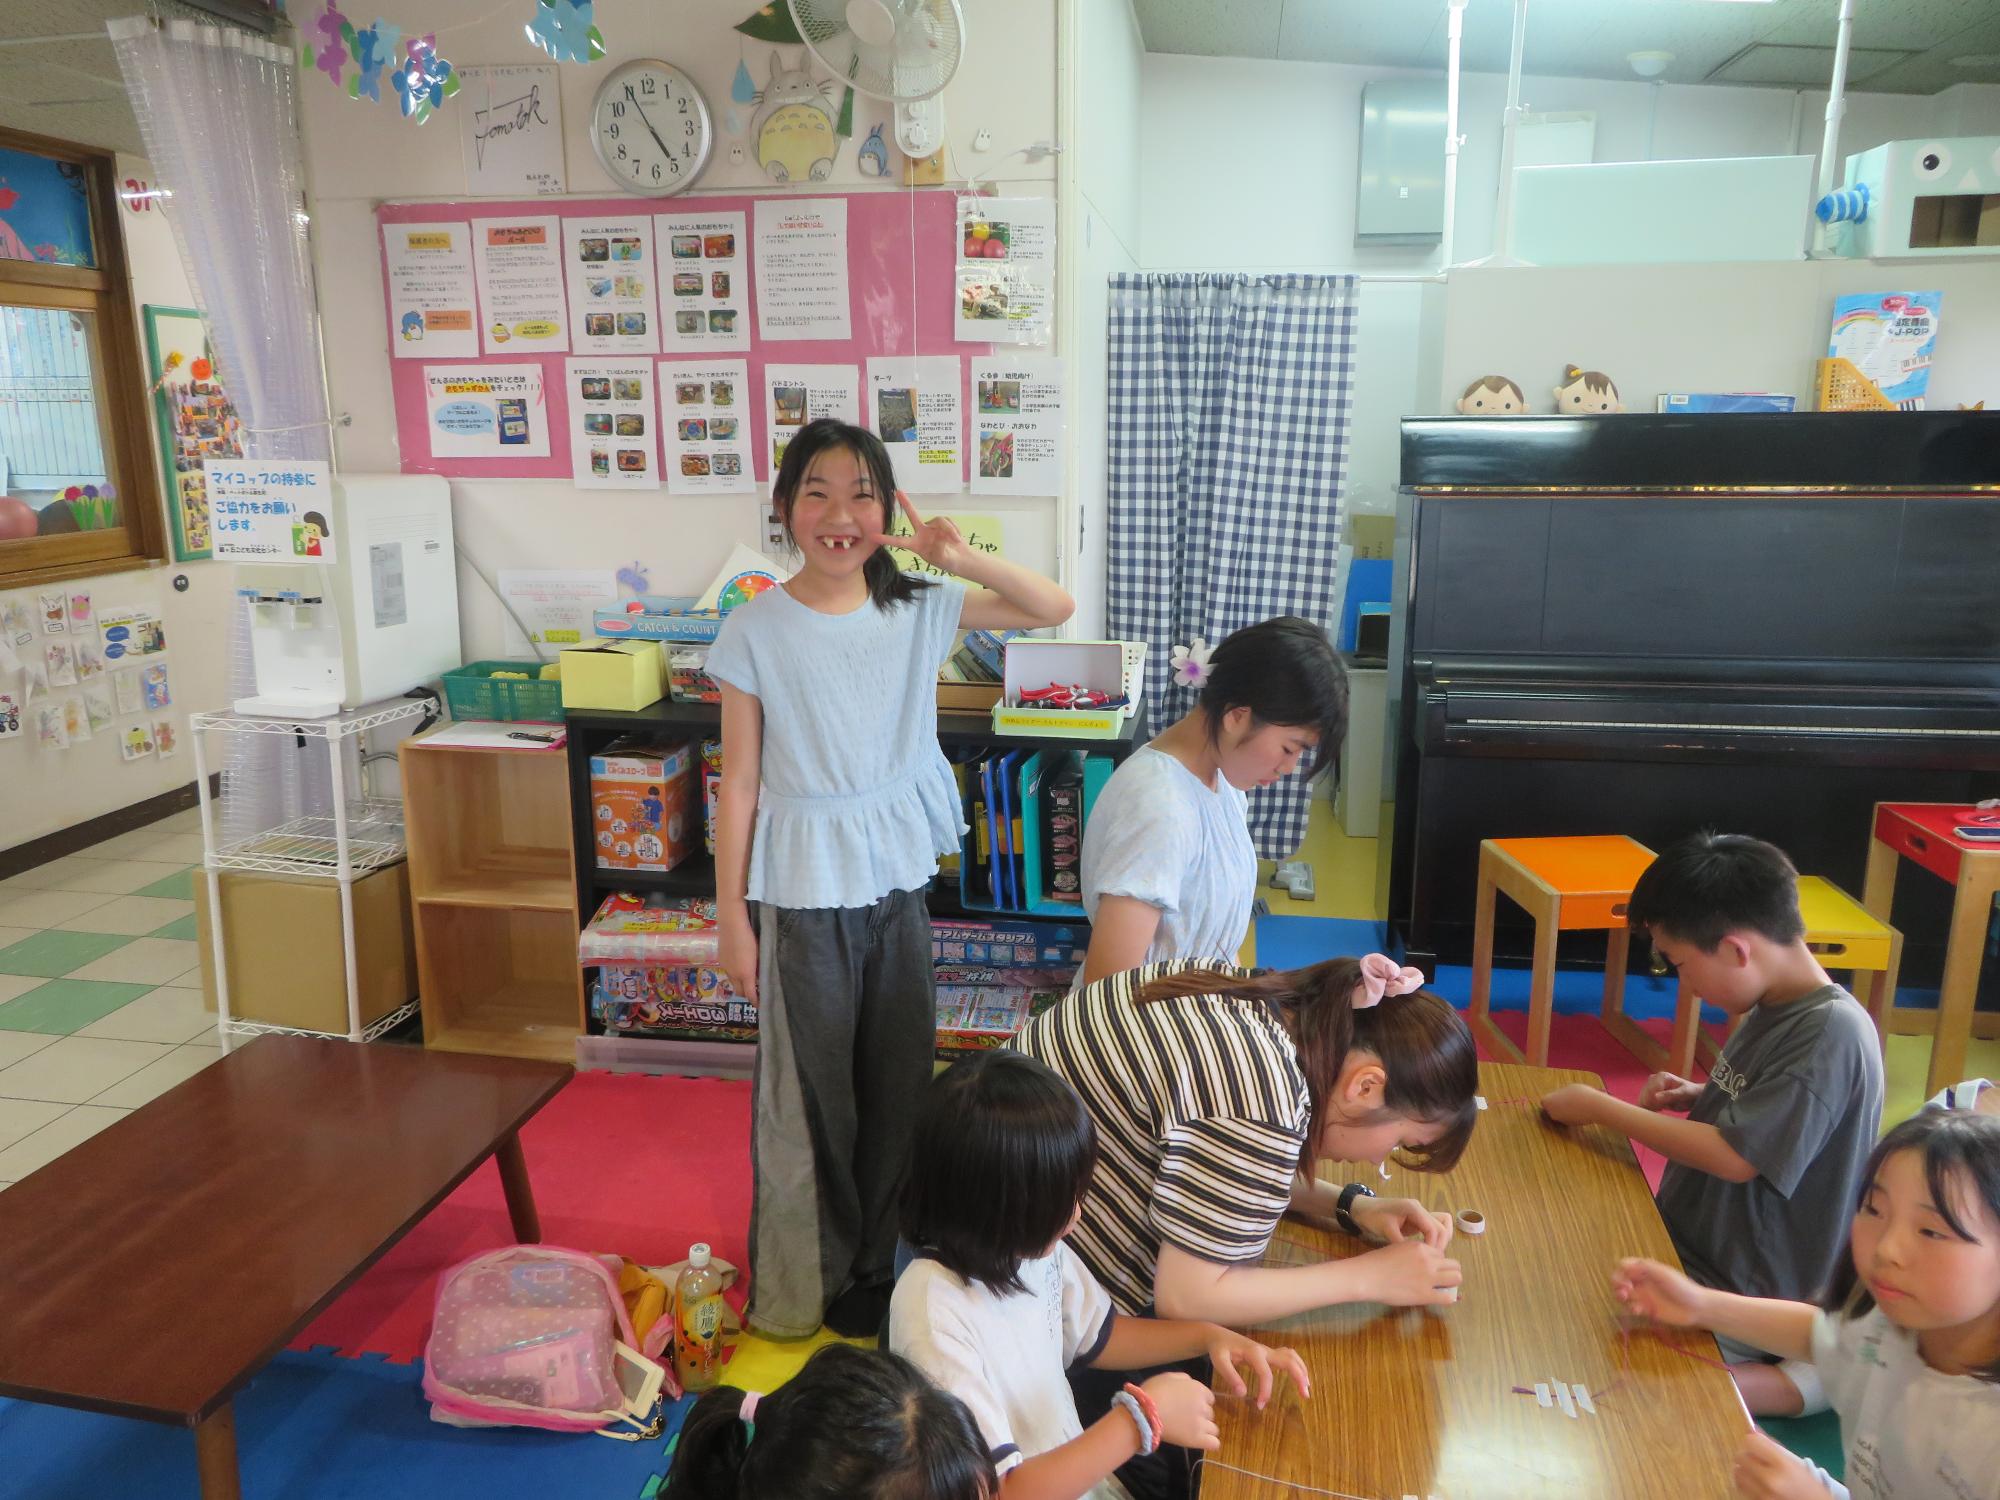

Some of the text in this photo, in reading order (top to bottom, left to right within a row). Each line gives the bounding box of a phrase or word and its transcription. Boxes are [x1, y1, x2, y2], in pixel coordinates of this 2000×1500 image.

[640, 78, 655, 94] 12
[664, 83, 670, 99] 1
[611, 101, 625, 117] 10
[678, 98, 687, 113] 2
[610, 123, 619, 139] 9
[685, 120, 694, 136] 3
[617, 144, 627, 160] 8
[681, 142, 690, 158] 4
[632, 159, 641, 175] 7
[651, 164, 661, 180] 6
[670, 158, 679, 173] 5
[211, 472, 317, 486] マイコップの持参に
[216, 501, 296, 514] ご協力をお願い
[217, 519, 256, 531] します。
[637, 622, 716, 634] CATCH & COUNT
